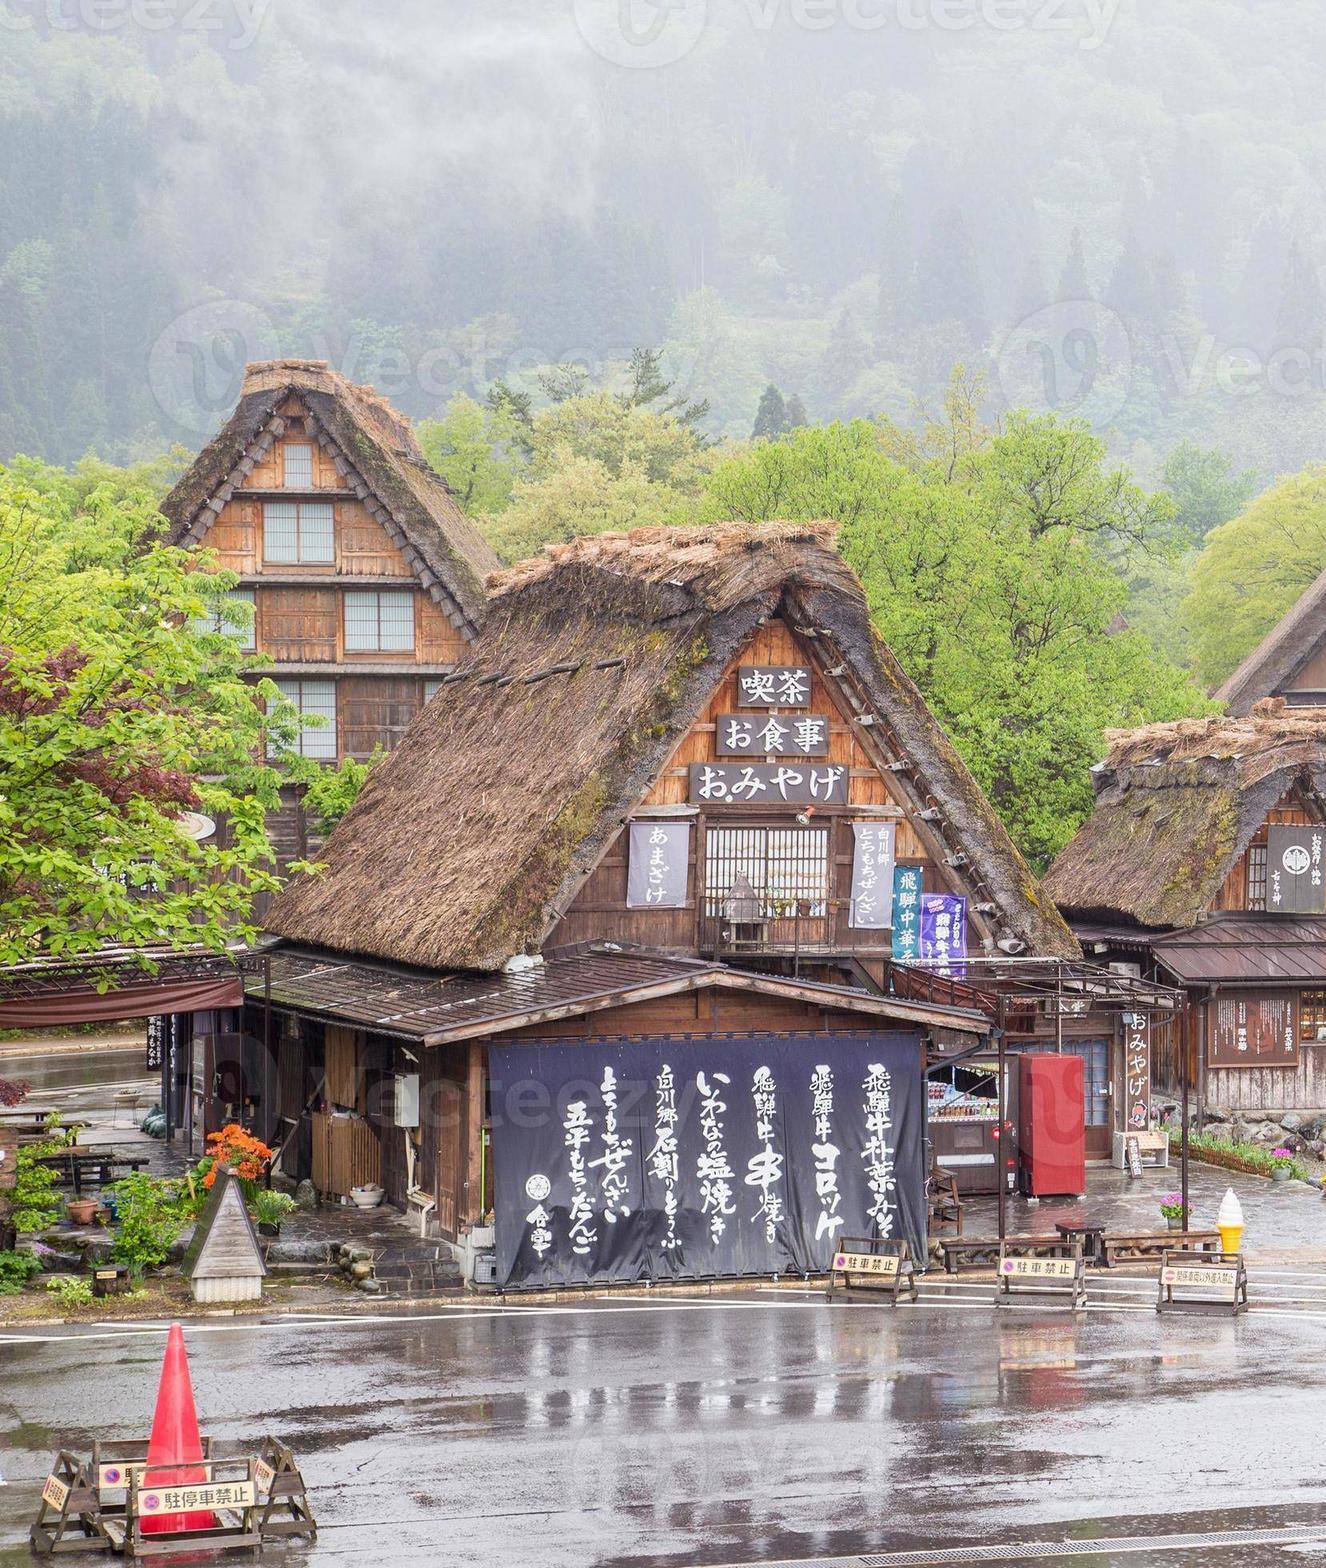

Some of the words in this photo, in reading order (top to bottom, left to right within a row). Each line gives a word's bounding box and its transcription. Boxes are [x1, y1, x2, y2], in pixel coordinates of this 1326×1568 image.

[740, 669, 810, 706] 喫茶
[725, 717, 824, 754] お食事
[698, 765, 844, 801] おみやげ
[646, 827, 669, 905] あまざけ
[856, 828, 878, 924] とちもちぜんざい
[877, 828, 890, 866] 白川郷
[1129, 1012, 1147, 1096] おみやげ
[588, 1066, 633, 1223] とちもちぜんざい
[696, 1070, 737, 1245] いわなの塩焼き
[744, 1065, 785, 1243] 飛騨牛串焼き
[809, 1064, 845, 1241] 飛騨牛コロッケ
[849, 1257, 894, 1271] 駐車禁止
[1017, 1260, 1070, 1275] 駐車禁止
[164, 1486, 249, 1509] 駐停車禁止
